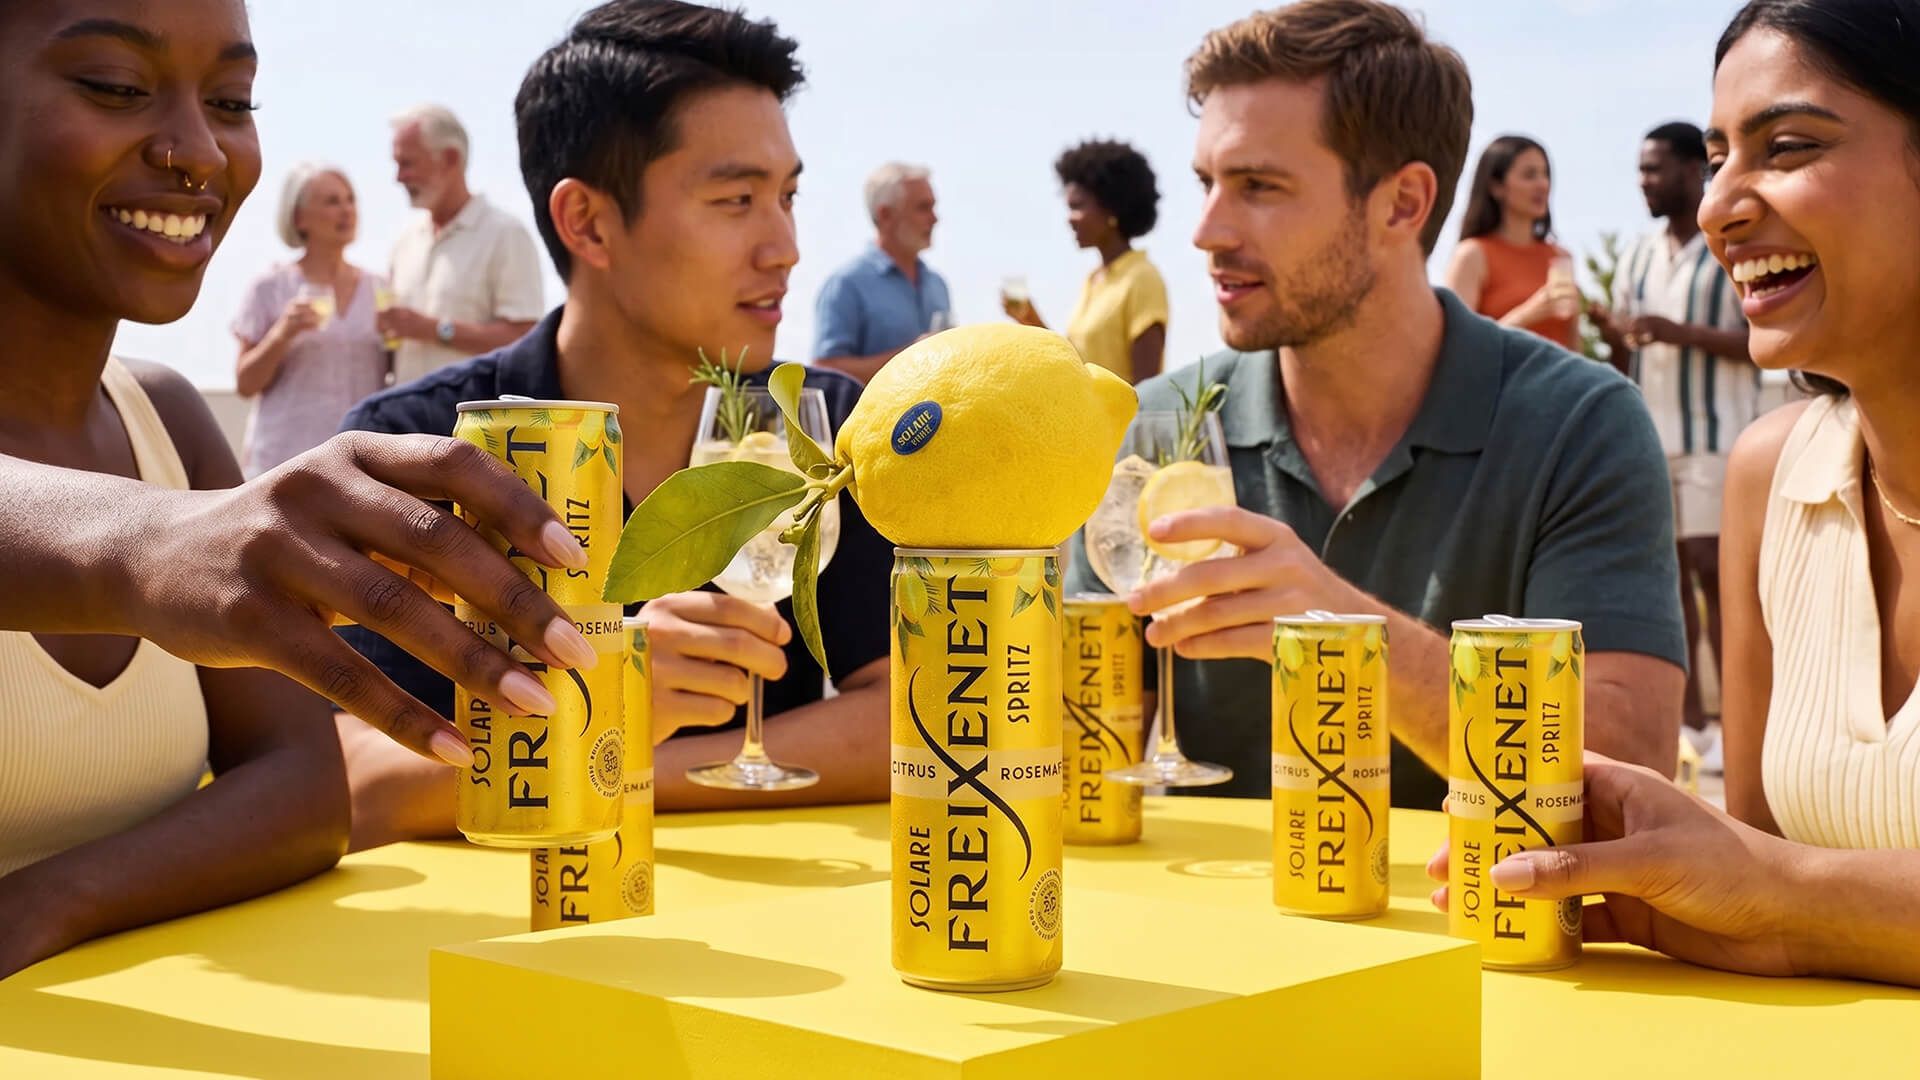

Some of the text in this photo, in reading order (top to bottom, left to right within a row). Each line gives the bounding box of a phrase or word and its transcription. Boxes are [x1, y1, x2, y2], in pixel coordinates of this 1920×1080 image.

[566, 498, 590, 579] SRITZ
[1007, 644, 1031, 723] SPRITZ
[1357, 685, 1373, 740] SPRITZ
[470, 697, 492, 787] SOLAR
[893, 761, 937, 779] CITRUS
[908, 574, 1032, 953] FREIXENET
[1288, 639, 1374, 894] FREIXENET
[1542, 702, 1560, 764] SPRITZ
[535, 847, 550, 908] SOLA
[909, 826, 931, 933] SOLARE
[1289, 808, 1306, 880] SOLARE
[1463, 840, 1481, 923] SOLARE
